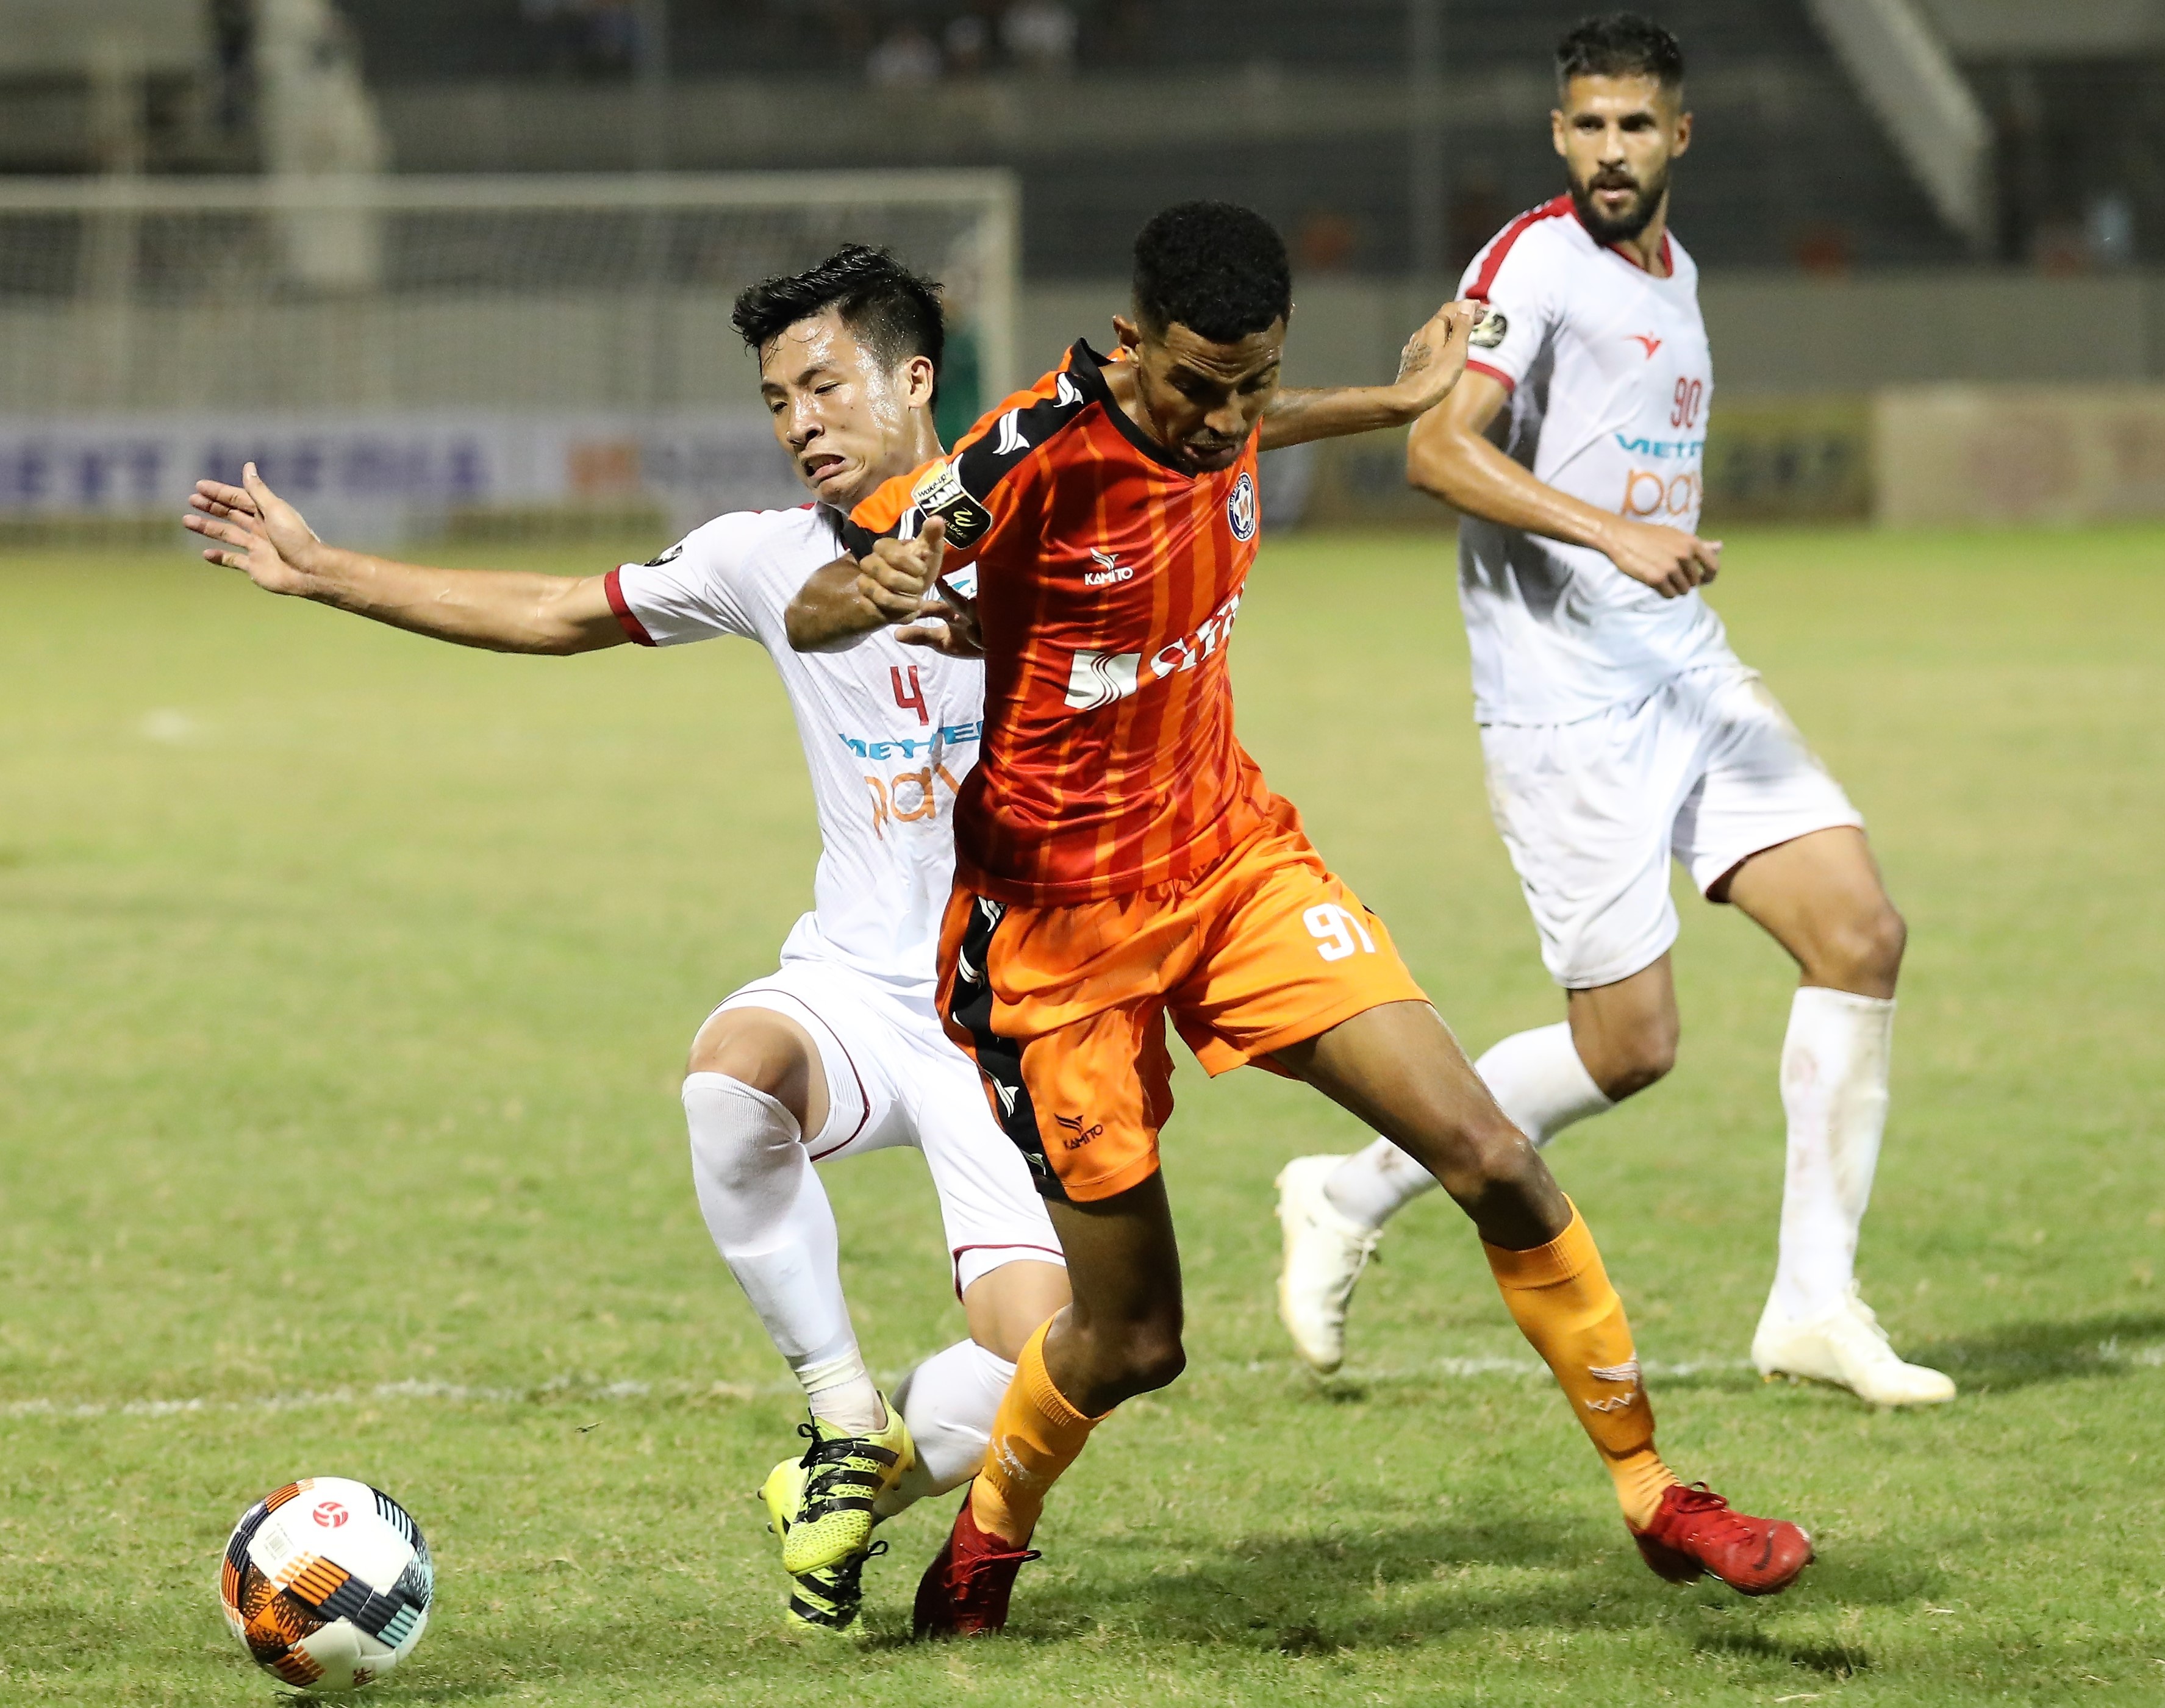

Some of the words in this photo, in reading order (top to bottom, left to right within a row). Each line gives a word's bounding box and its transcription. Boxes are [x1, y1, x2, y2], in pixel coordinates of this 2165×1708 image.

[1670, 376, 1702, 429] 90
[1084, 567, 1133, 585] KAMITO
[890, 665, 929, 726] 4
[1303, 903, 1376, 962] 91
